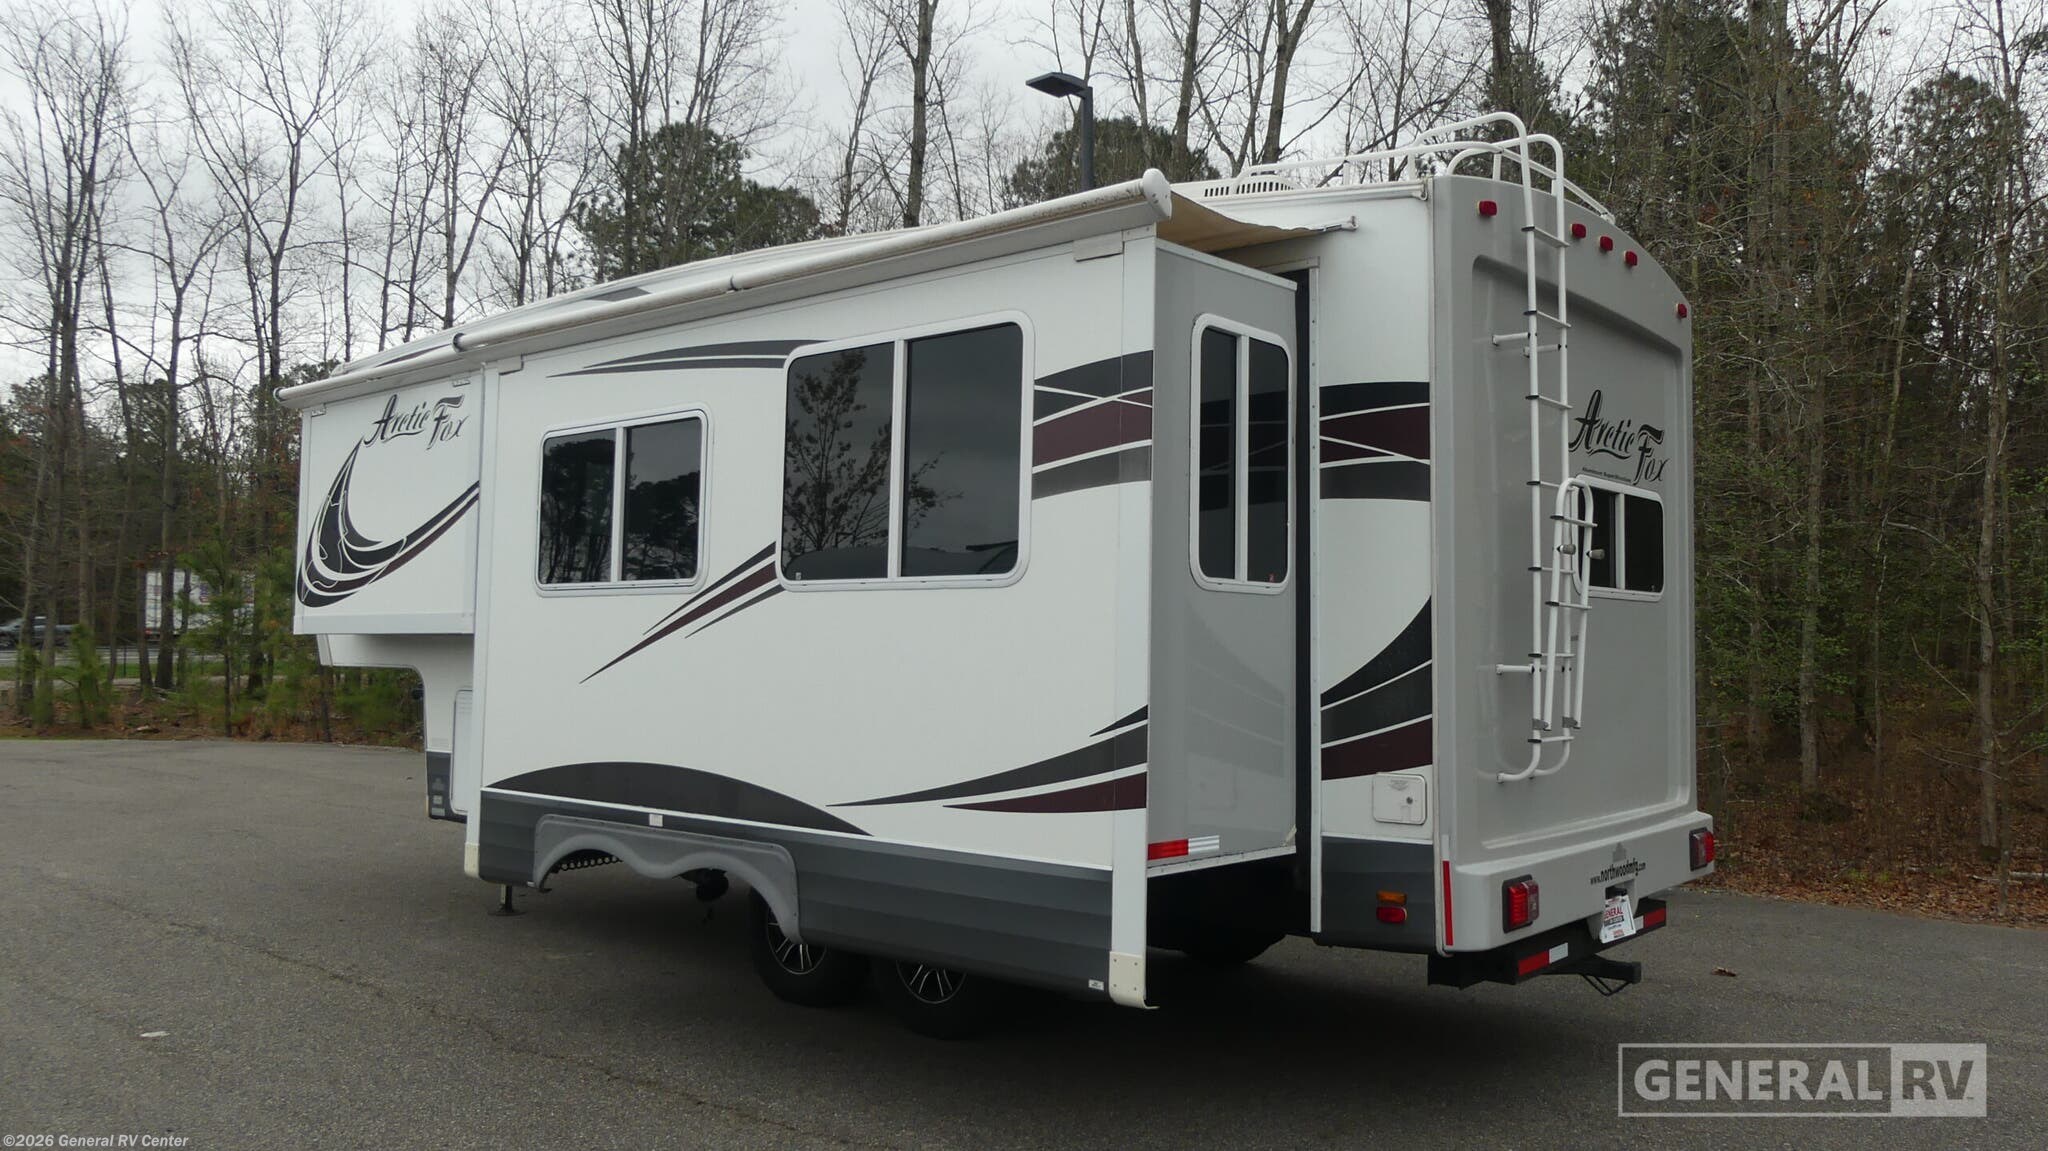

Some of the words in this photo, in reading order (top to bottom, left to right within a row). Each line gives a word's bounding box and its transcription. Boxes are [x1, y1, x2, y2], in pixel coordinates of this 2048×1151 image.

[363, 393, 431, 447] Arctic
[426, 394, 470, 450] Fox
[1568, 389, 1636, 459] Arctic
[1632, 424, 1670, 486] Fox
